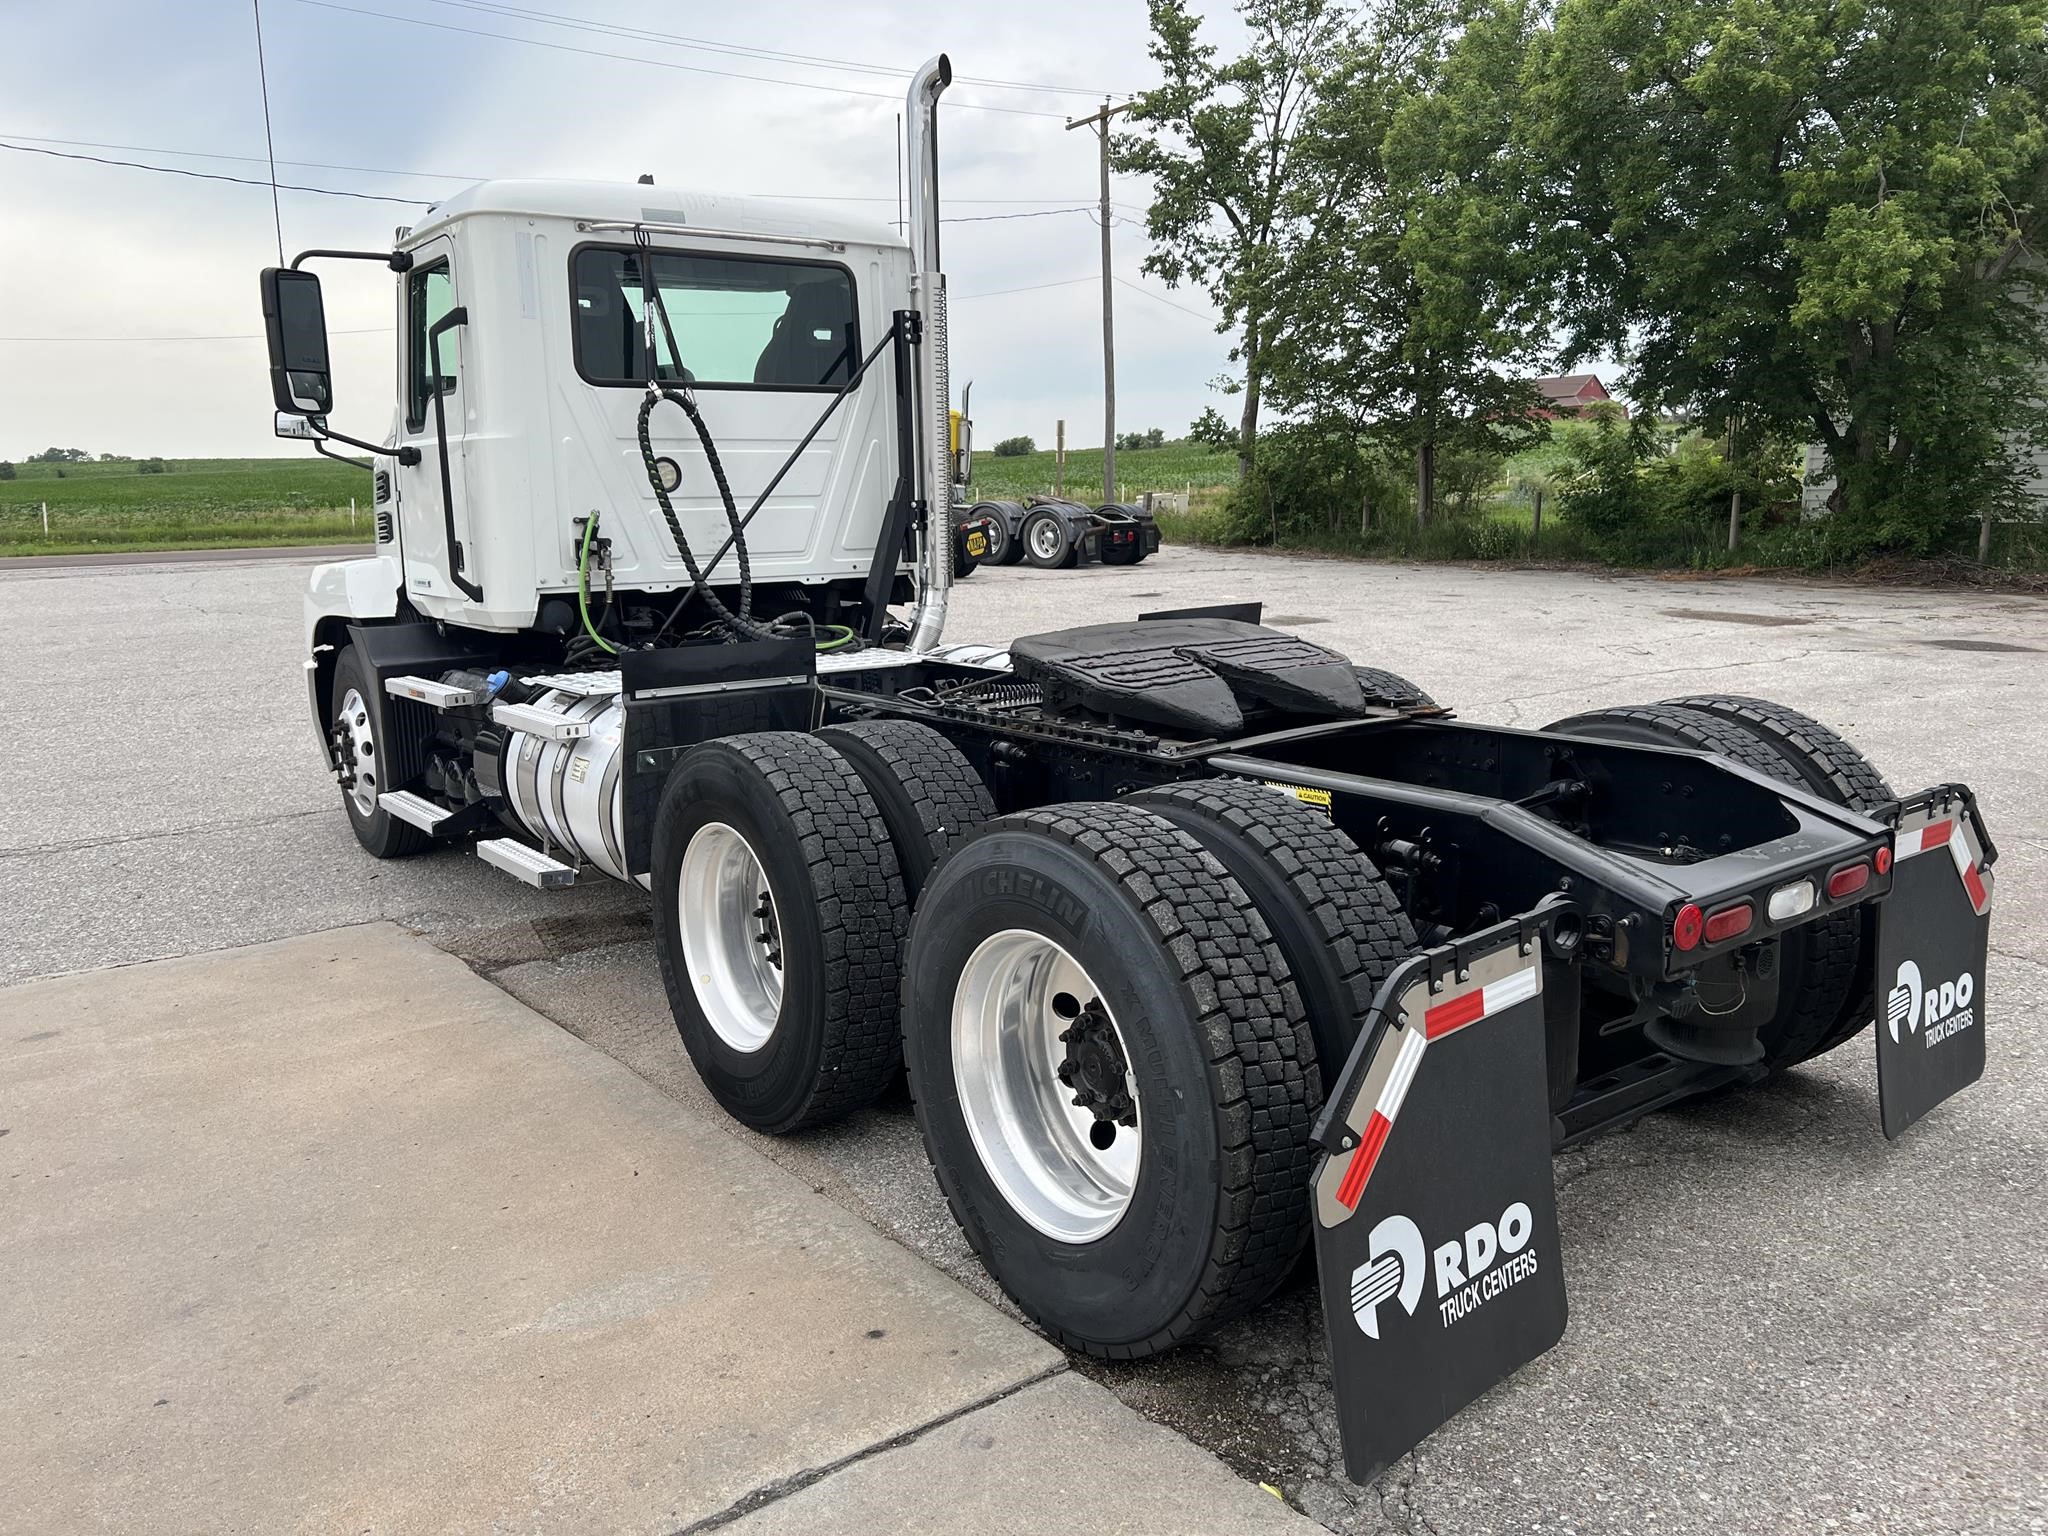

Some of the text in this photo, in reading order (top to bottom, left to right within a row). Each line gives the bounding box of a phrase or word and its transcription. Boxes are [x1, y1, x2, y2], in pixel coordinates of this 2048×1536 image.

[968, 536, 985, 552] NAPA
[1303, 793, 1327, 802] CAUTION
[949, 870, 1085, 927] MICHELIN
[1925, 972, 1973, 1027] RDO
[1925, 1007, 1973, 1049] TRUCK CENTERS
[1433, 1202, 1533, 1298] RDO
[1439, 1249, 1538, 1328] TRUCK CENTERS
